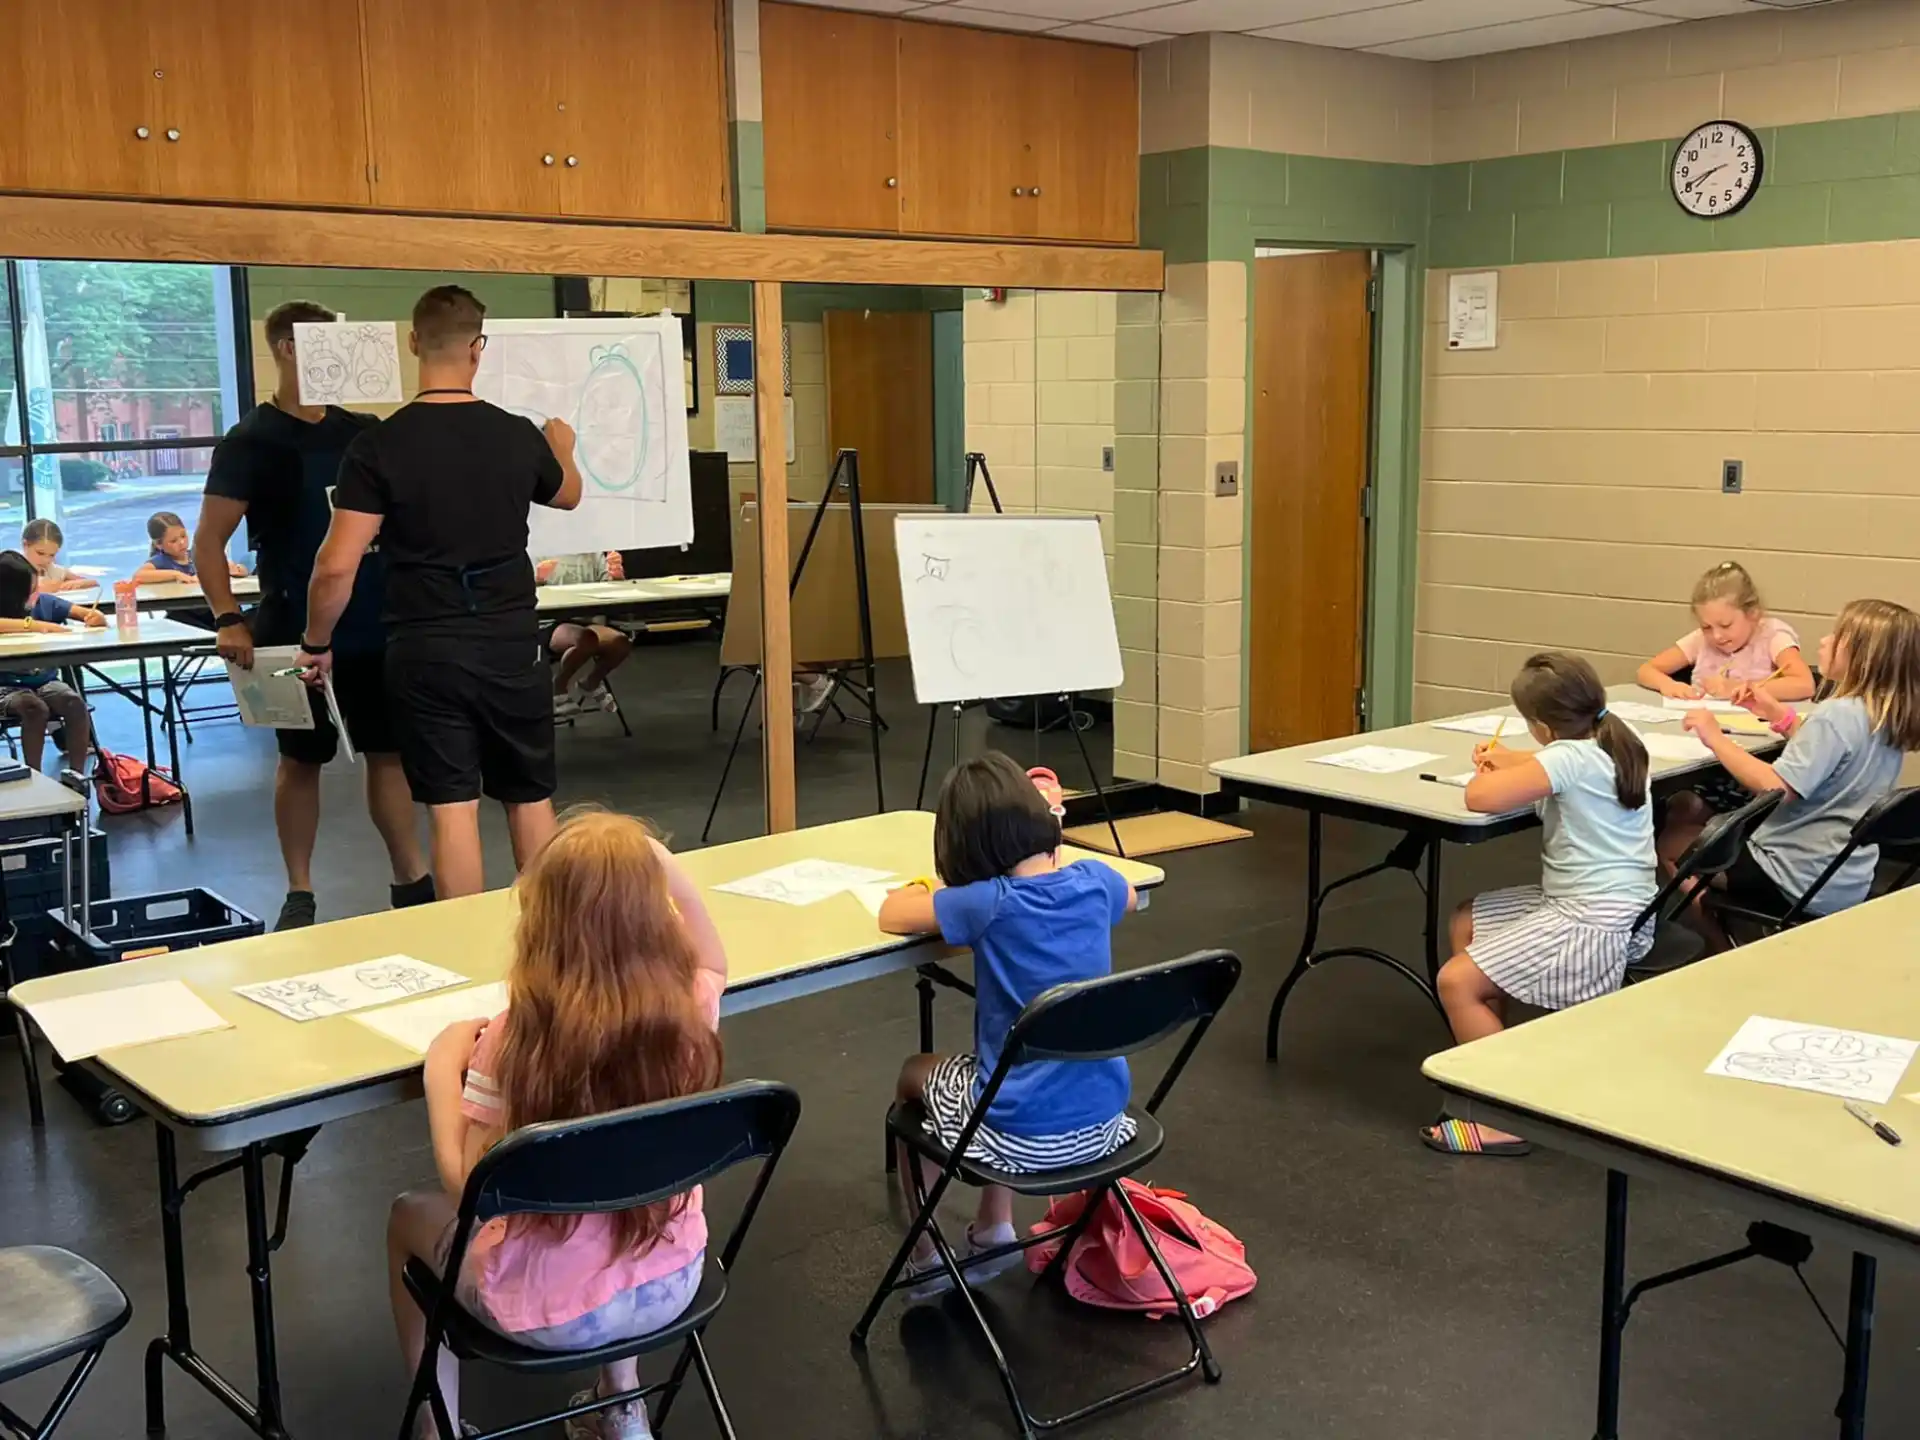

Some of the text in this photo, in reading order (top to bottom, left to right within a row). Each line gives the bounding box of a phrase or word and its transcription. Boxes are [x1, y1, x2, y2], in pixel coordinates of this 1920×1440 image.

[1700, 137, 1708, 149] 11
[1711, 131, 1723, 144] 12
[1730, 135, 1735, 148] 1
[1687, 150, 1699, 162] 10
[1737, 145, 1746, 158] 2
[1681, 166, 1689, 178] 9
[1740, 161, 1749, 173] 3
[1684, 181, 1692, 193] 8
[1735, 177, 1743, 189] 4
[1695, 192, 1703, 203] 7
[1708, 195, 1717, 207] 6
[1724, 189, 1732, 201] 5
